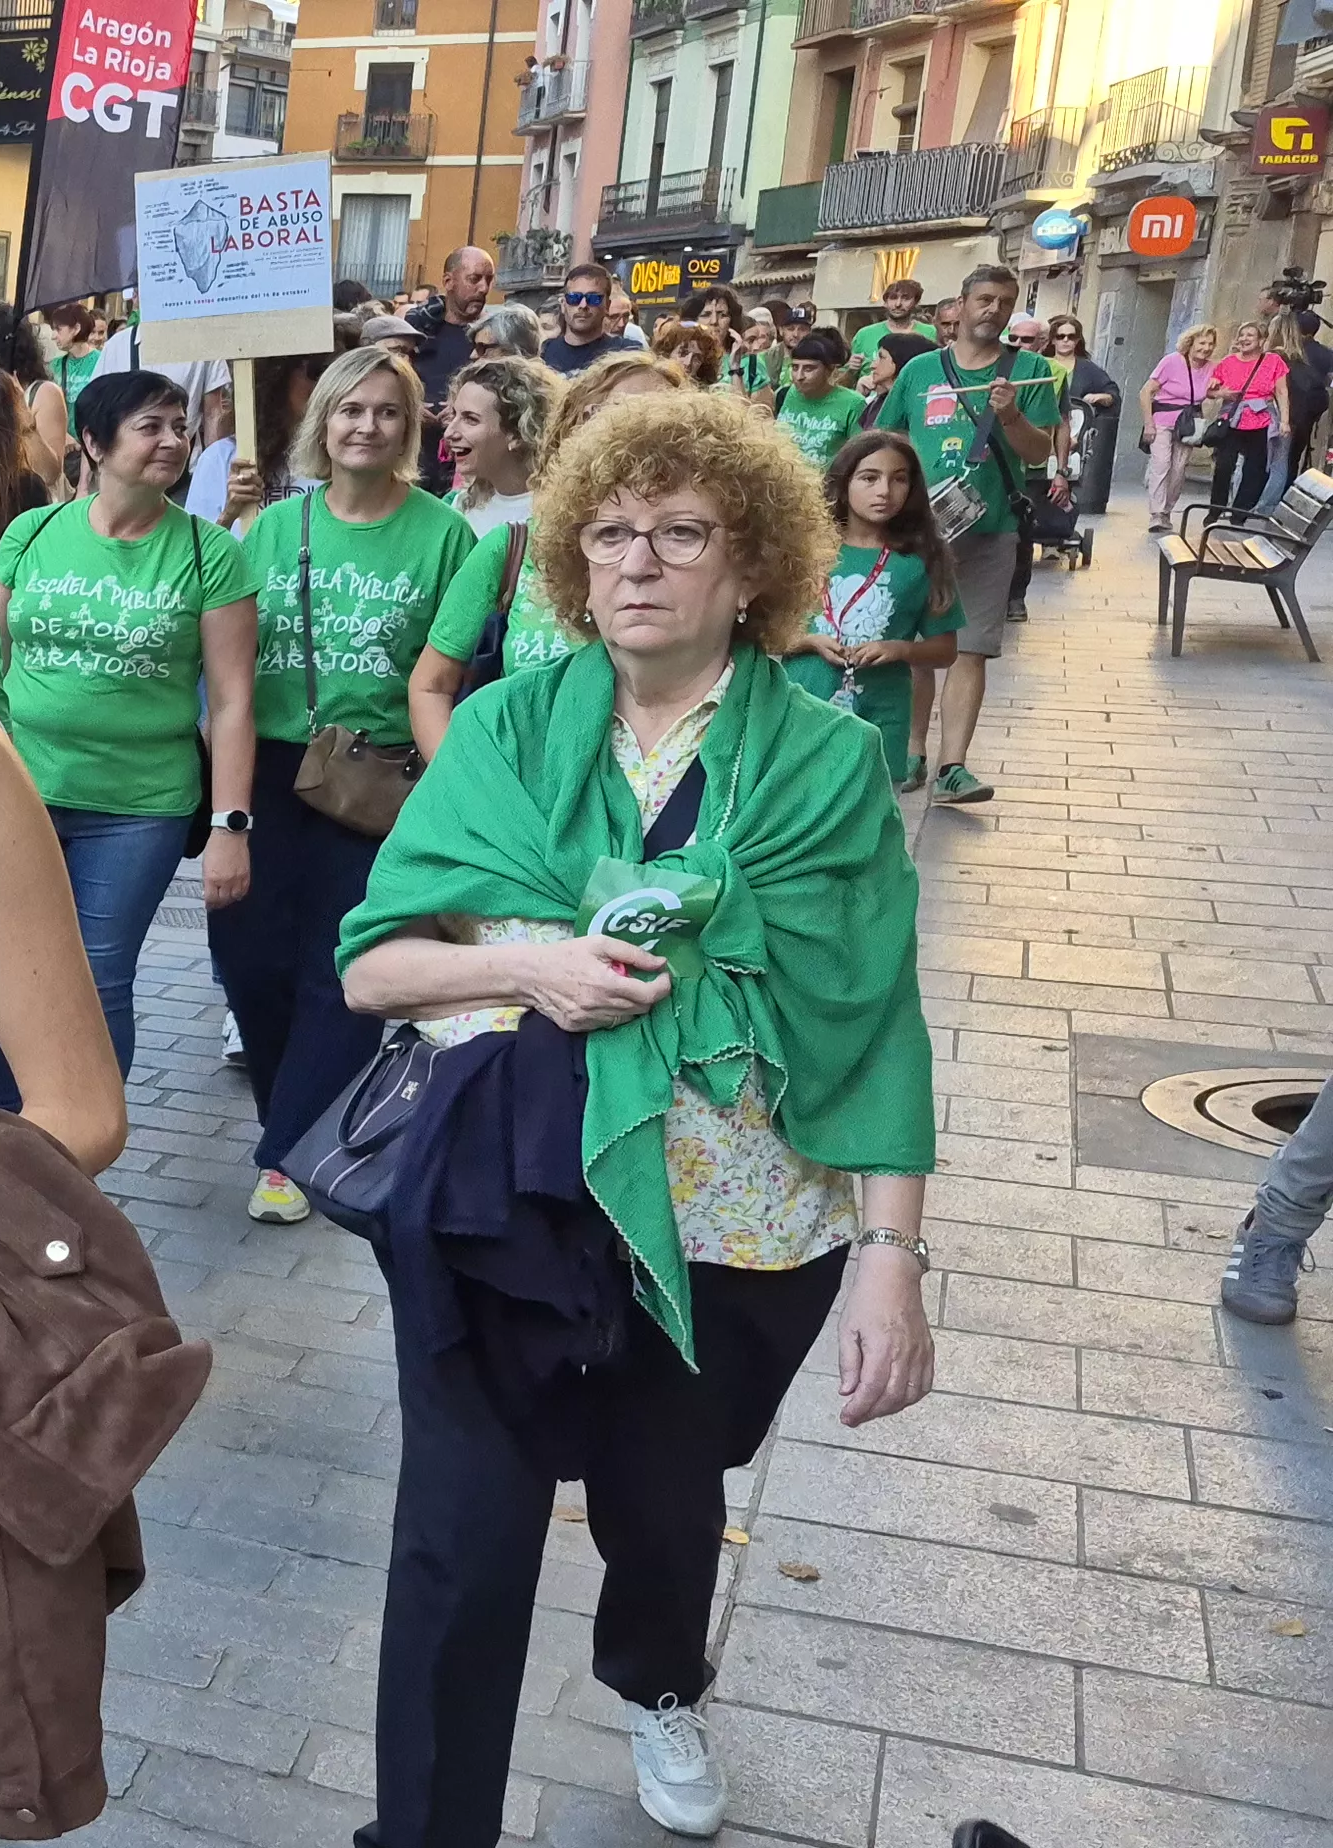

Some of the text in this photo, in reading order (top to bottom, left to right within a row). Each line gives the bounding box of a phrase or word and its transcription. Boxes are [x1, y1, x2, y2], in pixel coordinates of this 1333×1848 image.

[79, 8, 171, 48] Aragón
[73, 37, 171, 82] La Rioja
[60, 72, 178, 138] CGT
[1258, 154, 1319, 164] TABACOS
[239, 188, 321, 216] BASTA
[240, 210, 323, 231] DE ABUSO
[211, 225, 323, 254] LABORAL
[632, 261, 658, 293] OVS
[688, 259, 720, 273] OVS
[26, 571, 102, 601] ESCUELA
[267, 567, 342, 593] ESCELA
[30, 616, 165, 648] DE TOD@S
[276, 614, 397, 641] DE TOD@S
[91, 651, 170, 678] TOD@S
[608, 908, 691, 934] CSIF
